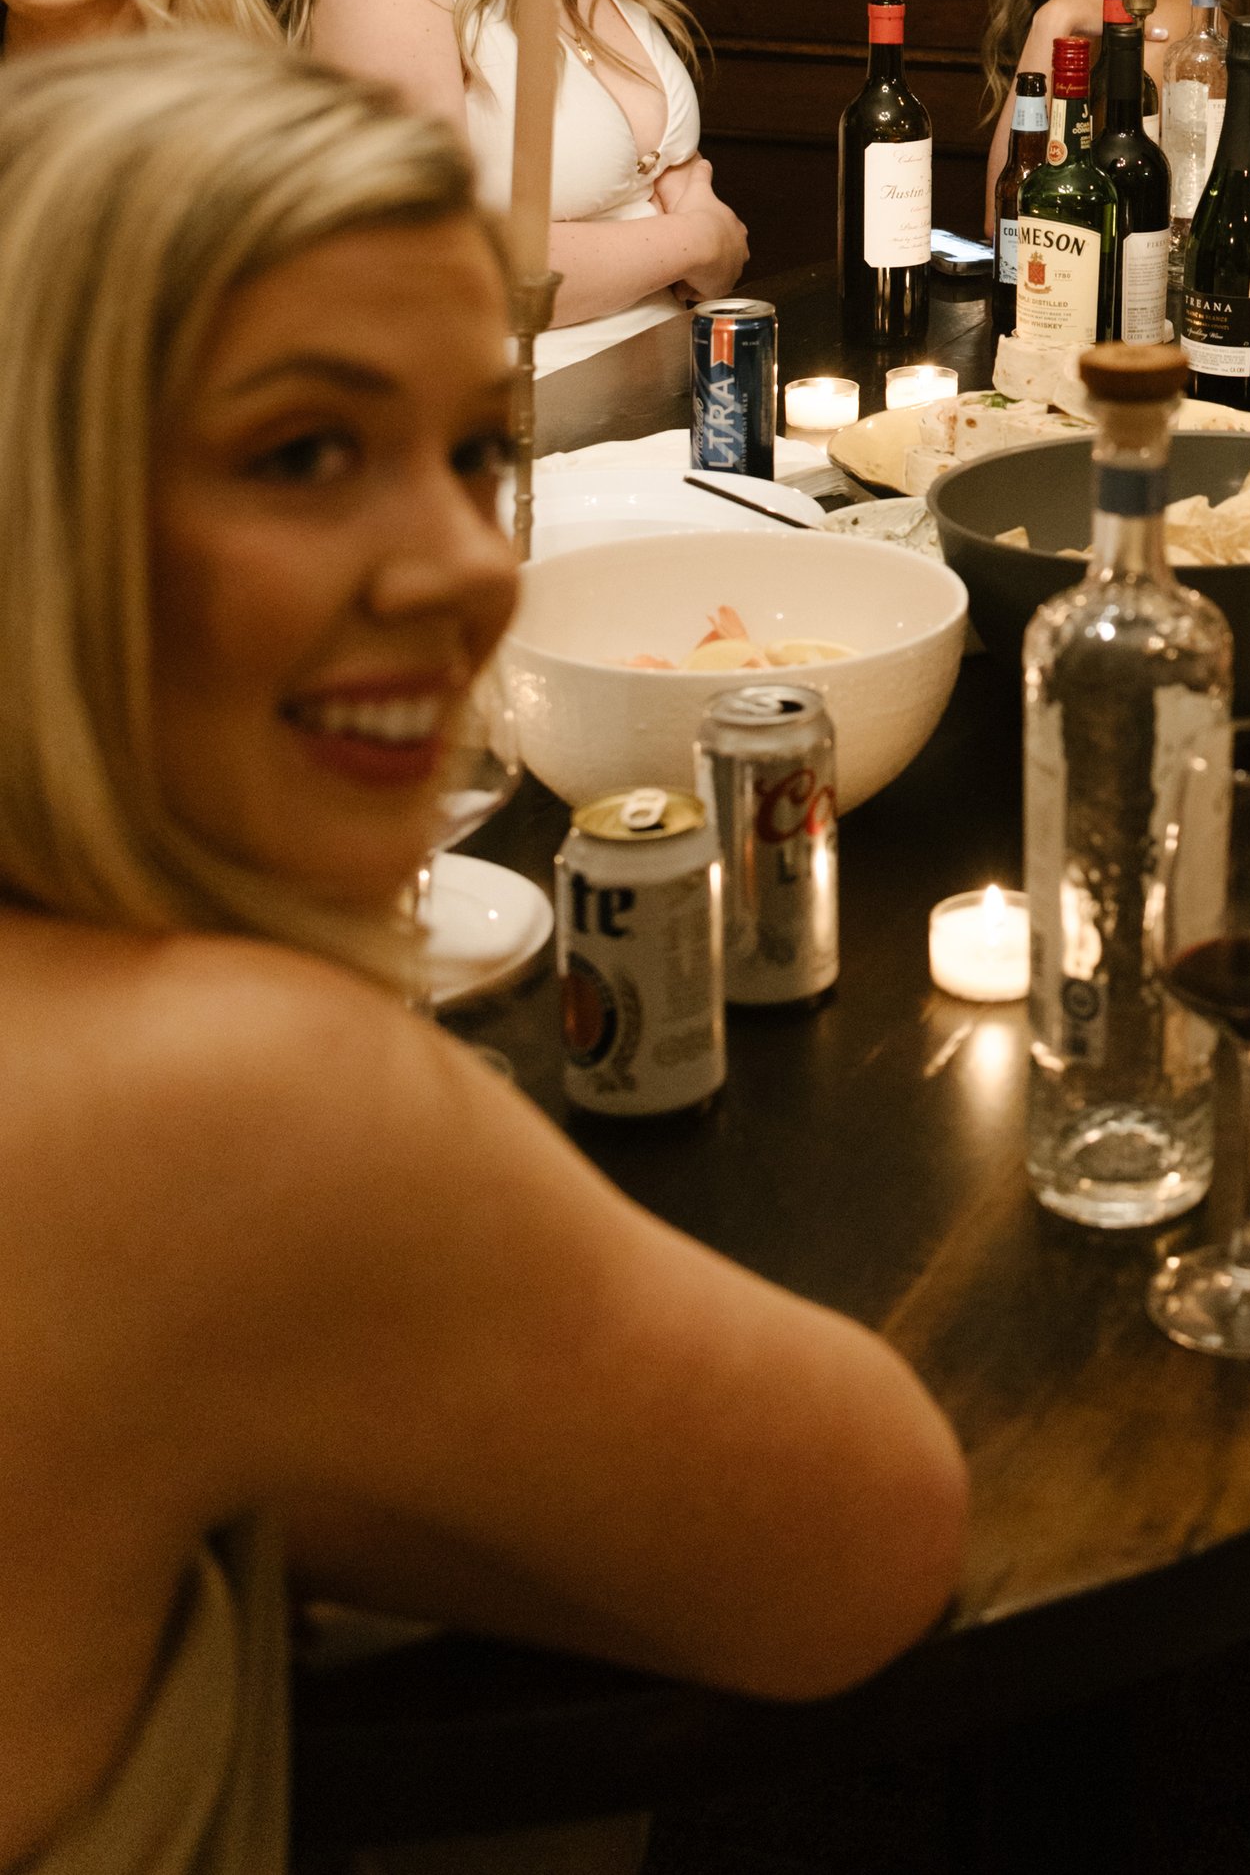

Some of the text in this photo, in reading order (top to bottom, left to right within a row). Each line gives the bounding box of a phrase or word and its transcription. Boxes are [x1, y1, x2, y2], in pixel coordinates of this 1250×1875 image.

[880, 184, 924, 200] Austin
[1018, 226, 1086, 257] MESON
[1032, 298, 1069, 308] DISTILLED
[1185, 294, 1233, 313] TREANA
[1031, 320, 1063, 329] WHISKEY
[708, 377, 736, 468] LTRA
[570, 872, 635, 939] te
